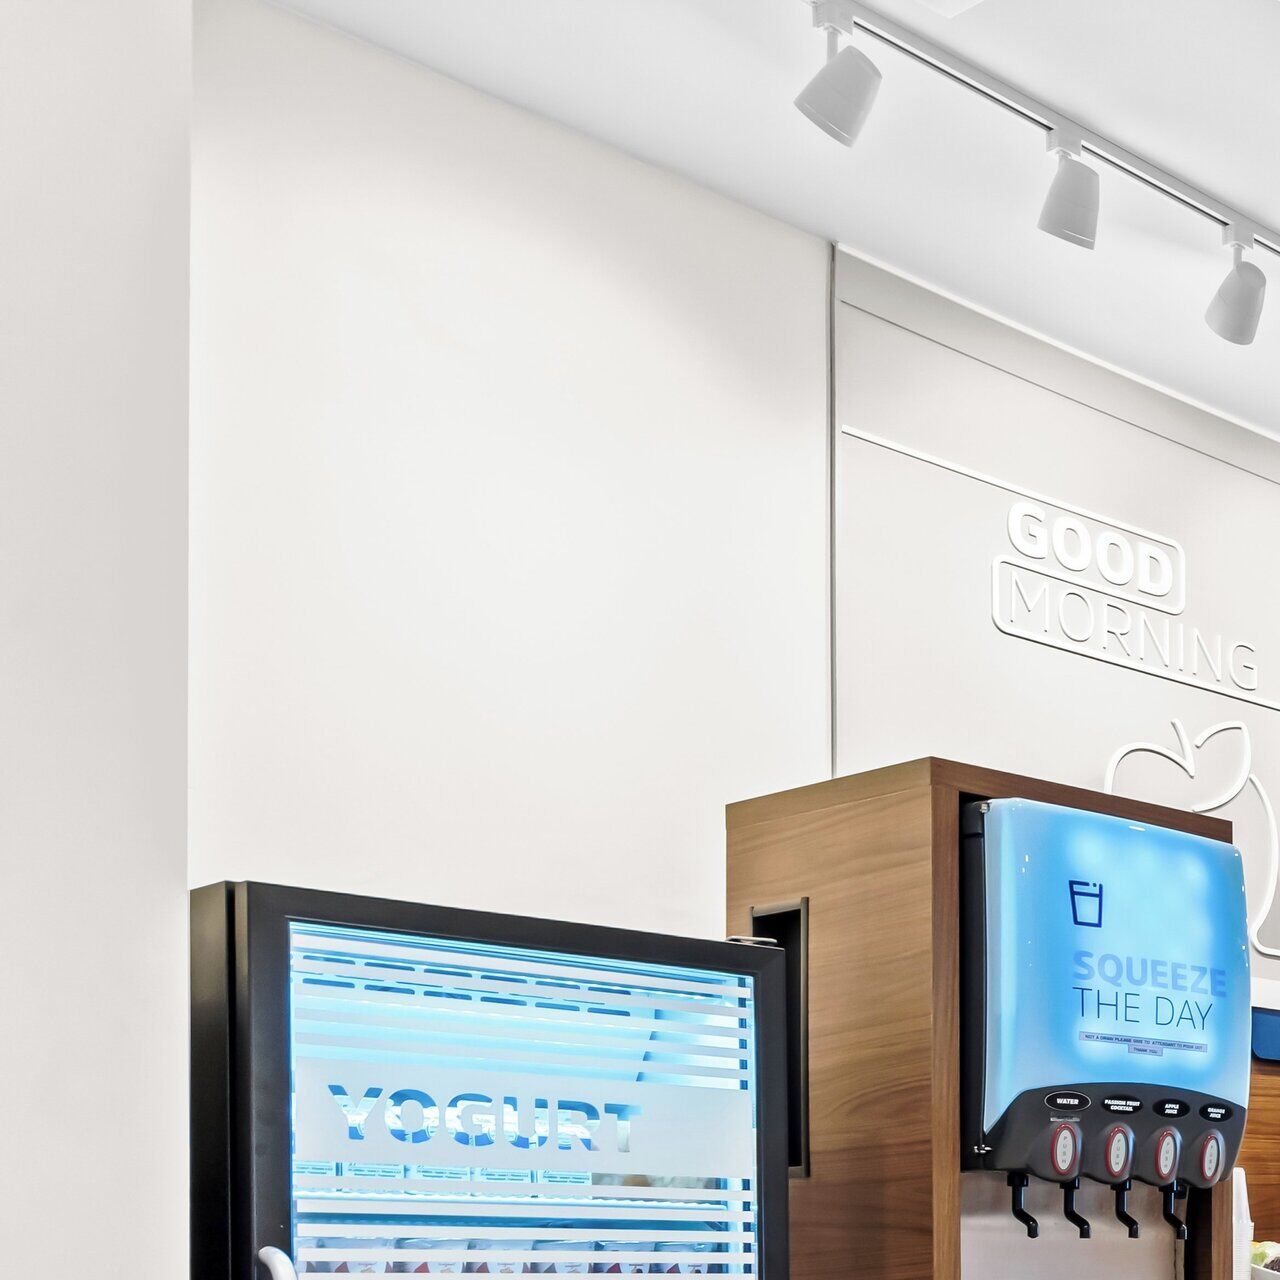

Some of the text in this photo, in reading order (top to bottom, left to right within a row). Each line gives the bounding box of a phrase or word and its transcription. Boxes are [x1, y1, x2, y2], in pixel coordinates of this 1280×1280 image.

[1007, 501, 1173, 597] GOOD
[1010, 570, 1258, 691] MORNING
[1072, 950, 1227, 998] SQUEEZE
[1072, 986, 1213, 1030] THE DAY
[328, 1084, 644, 1153] YOGURT
